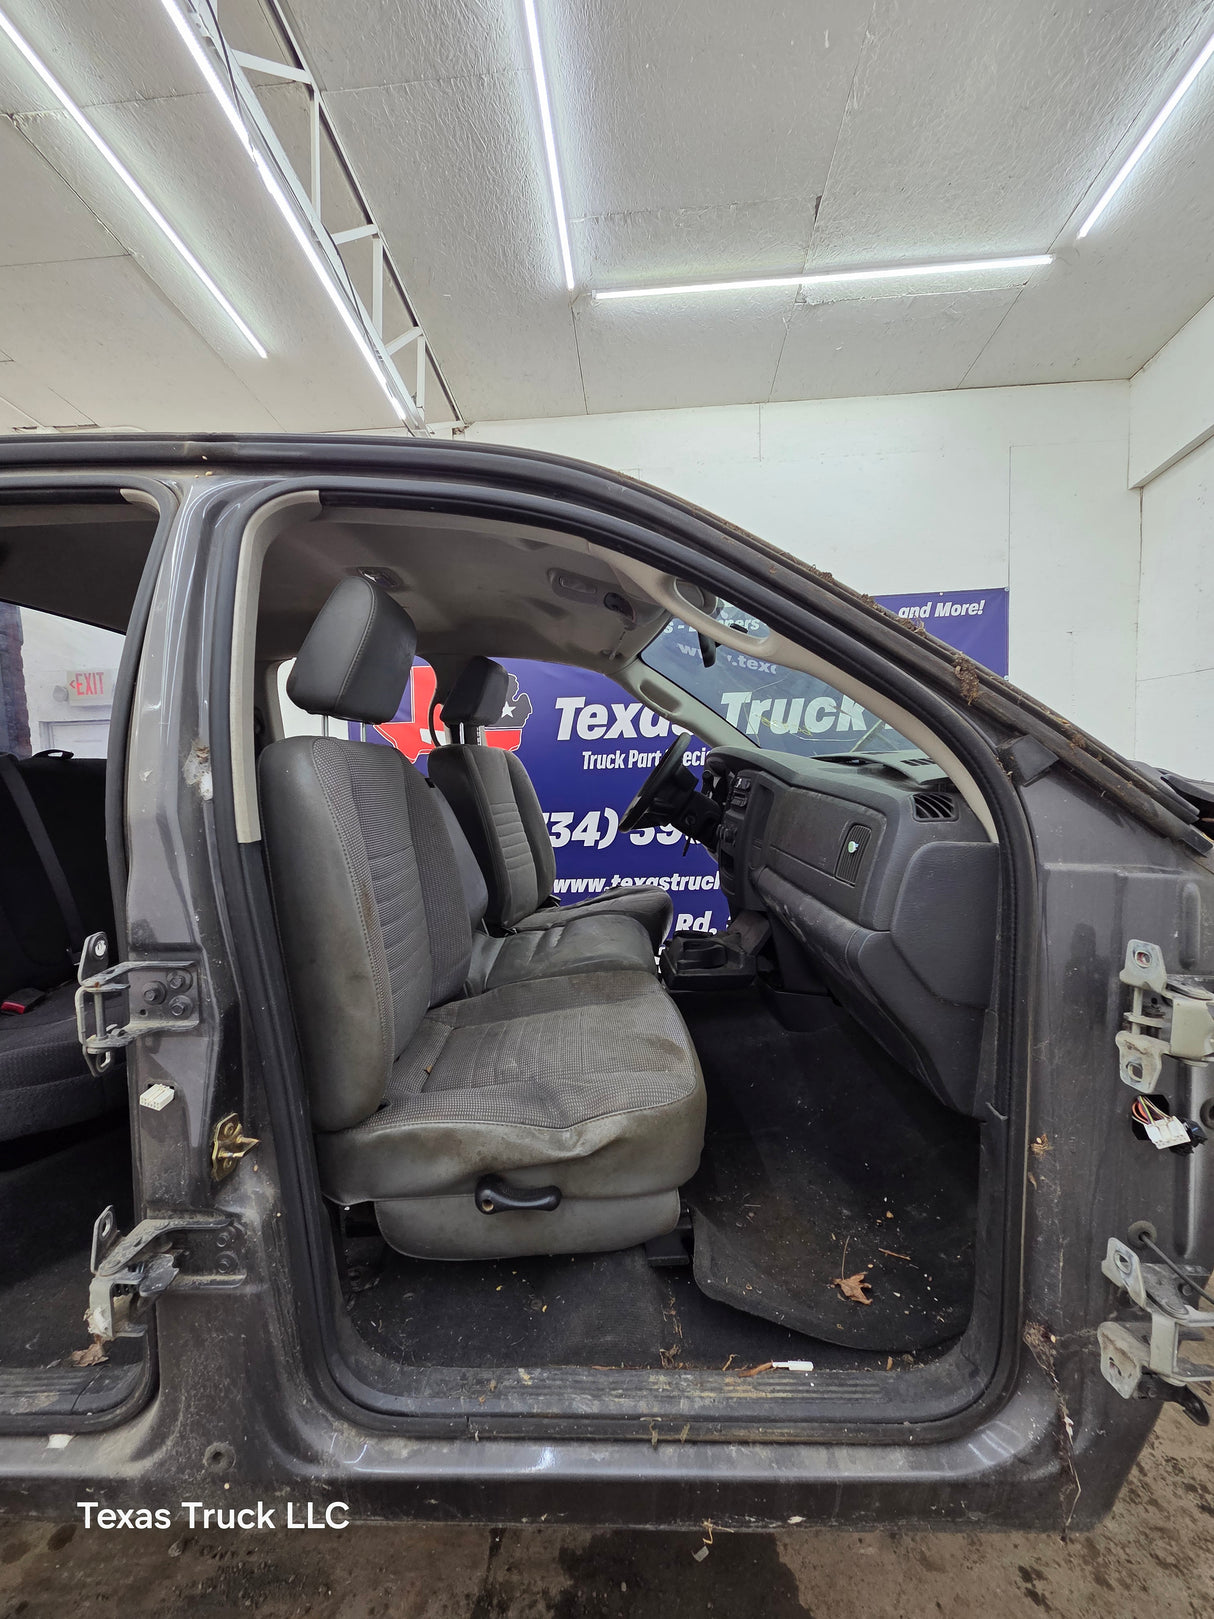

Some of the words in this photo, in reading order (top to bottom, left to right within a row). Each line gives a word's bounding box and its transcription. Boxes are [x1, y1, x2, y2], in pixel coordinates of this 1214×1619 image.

[898, 602, 932, 619] and
[934, 600, 985, 617] More!
[75, 672, 104, 696] EXIT
[555, 696, 694, 741] Texa
[721, 692, 867, 735] Truck
[582, 750, 625, 770] Truck
[675, 910, 718, 936] Rd.
